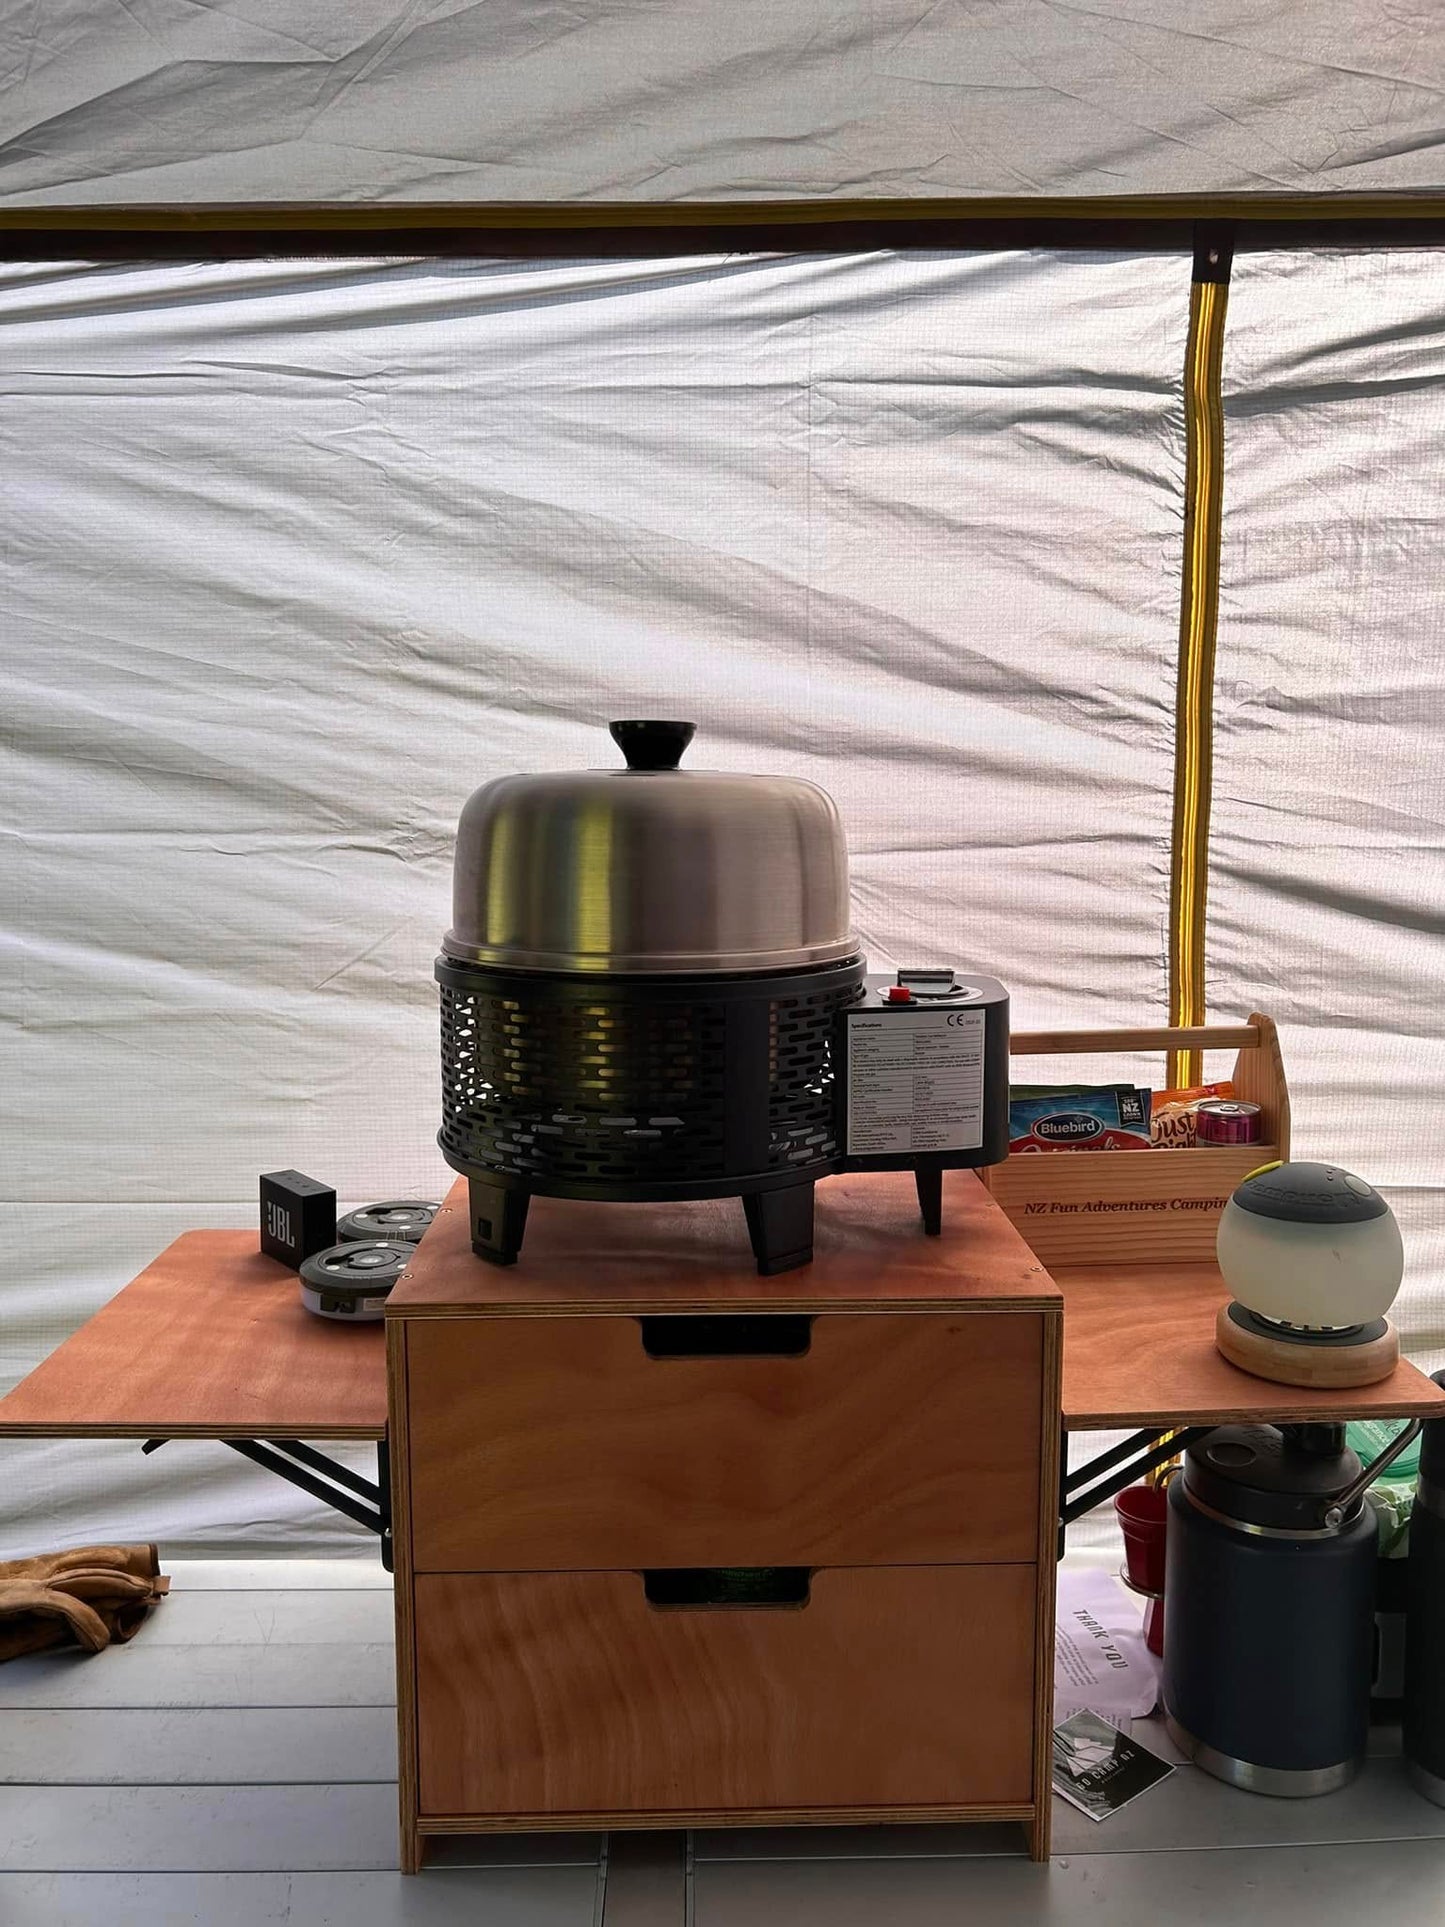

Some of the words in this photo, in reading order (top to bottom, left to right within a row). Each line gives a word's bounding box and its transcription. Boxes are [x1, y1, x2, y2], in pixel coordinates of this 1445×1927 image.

[1122, 1102, 1140, 1113] NZ
[1041, 1119, 1095, 1134] Bluebird
[1151, 1111, 1194, 1143] Just
[1024, 1203, 1047, 1214] NZ
[1051, 1201, 1079, 1214] Fun
[1084, 1200, 1167, 1212] Adventures
[1171, 1197, 1228, 1212] Campin
[267, 1201, 295, 1248] JBL
[1100, 1645, 1129, 1669] YOU
